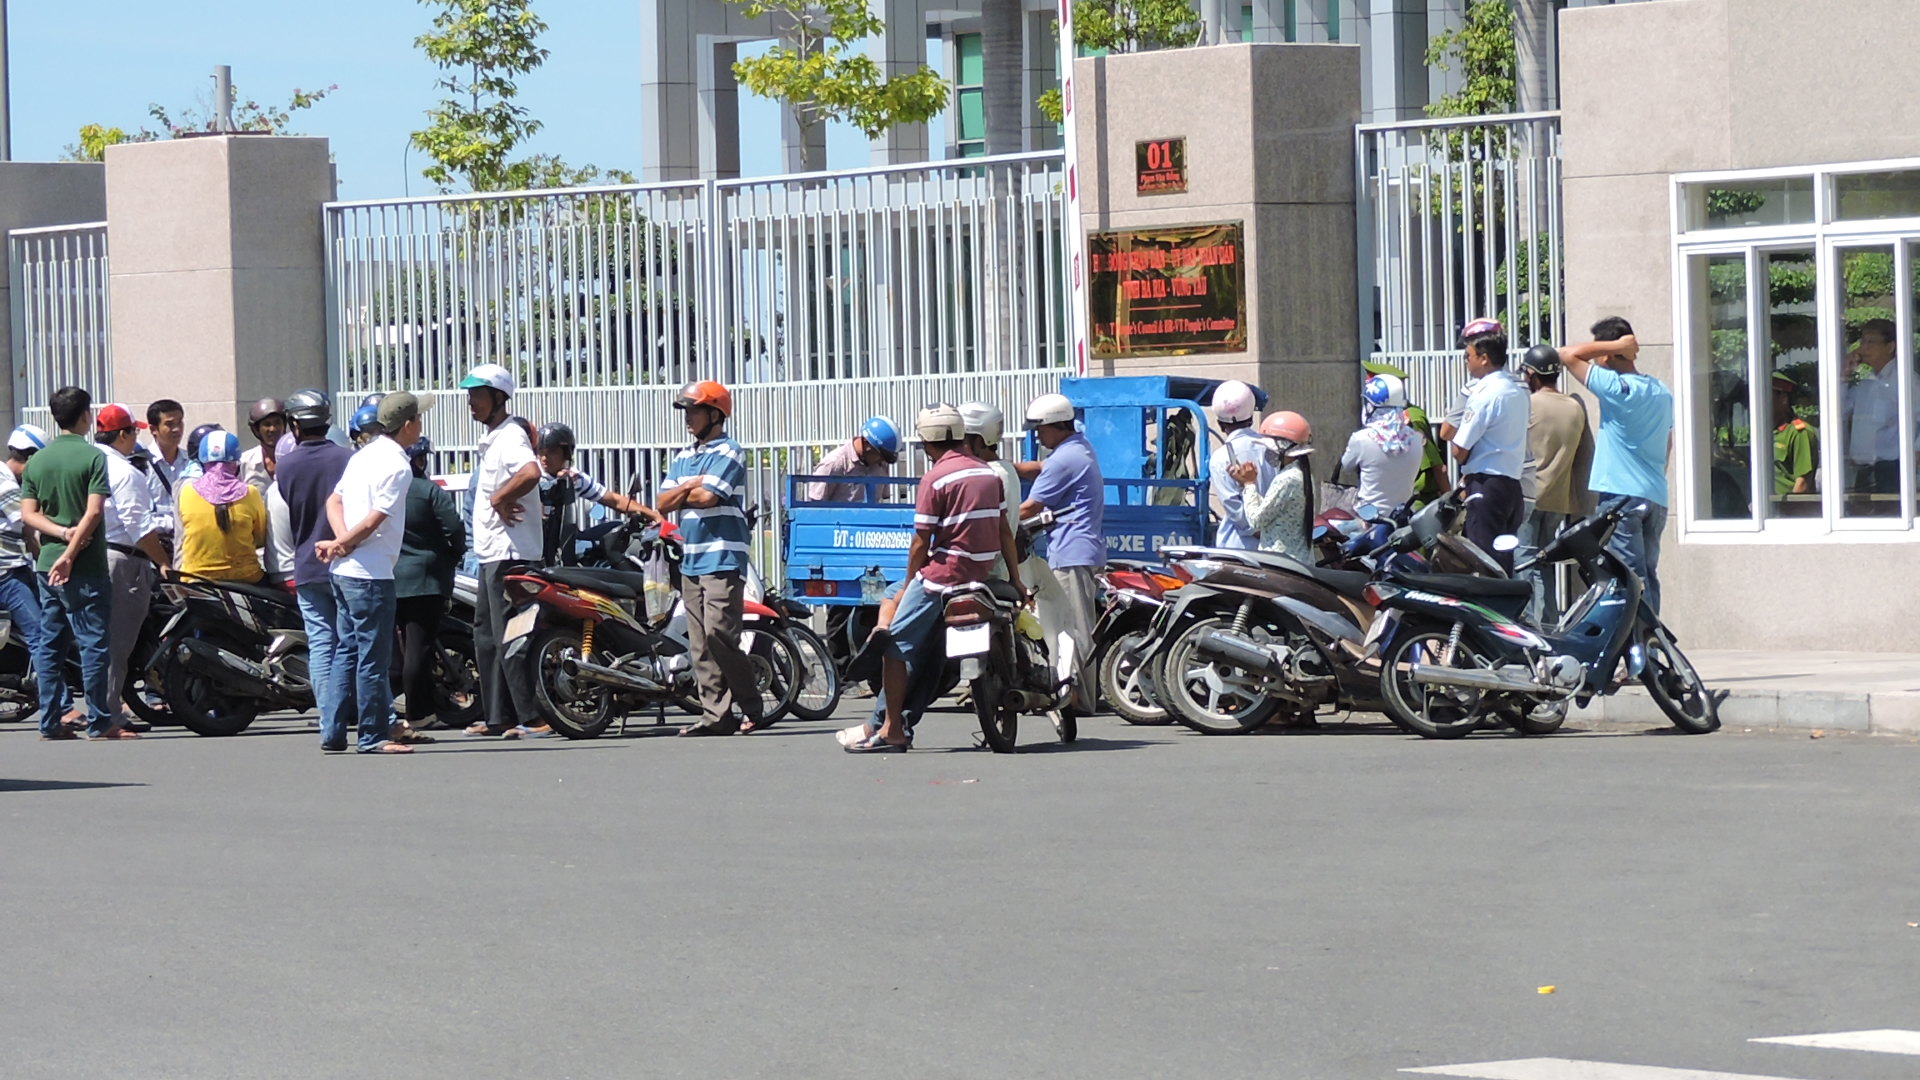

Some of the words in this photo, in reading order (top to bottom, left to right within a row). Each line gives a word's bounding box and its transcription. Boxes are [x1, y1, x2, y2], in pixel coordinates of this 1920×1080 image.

[1147, 141, 1172, 169] 01
[855, 531, 912, 548] 01699262669
[1118, 534, 1146, 552] XE
